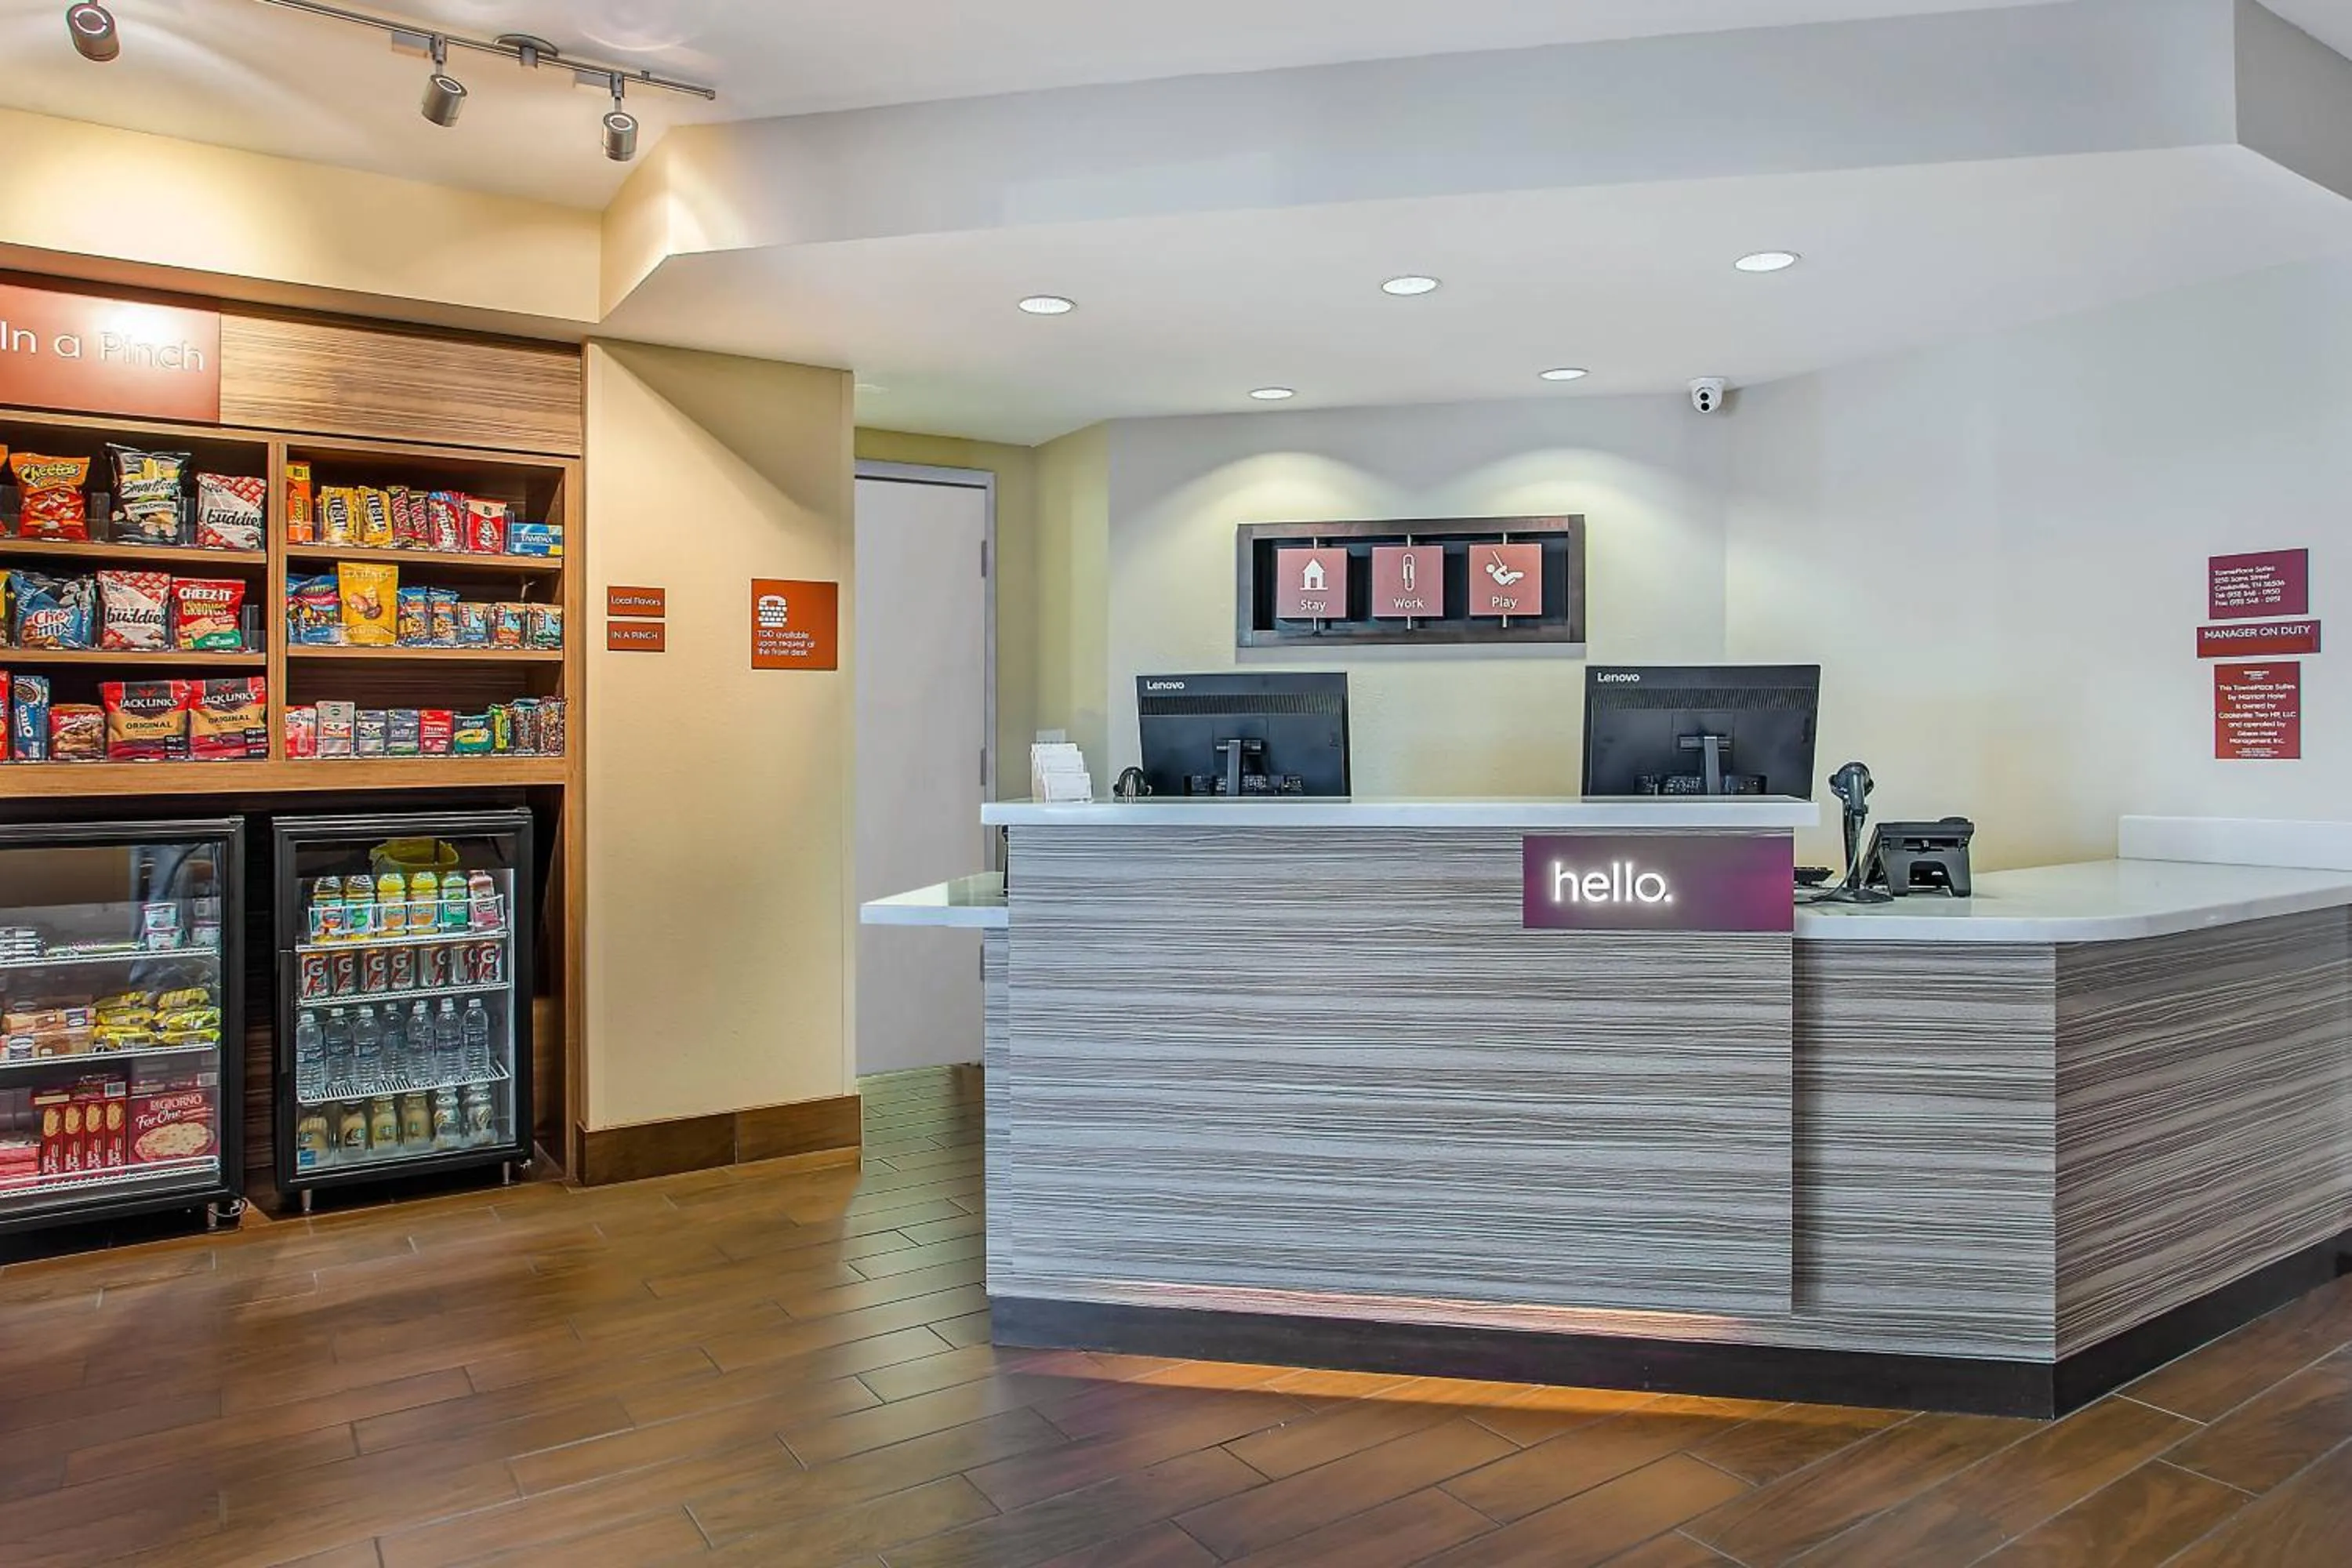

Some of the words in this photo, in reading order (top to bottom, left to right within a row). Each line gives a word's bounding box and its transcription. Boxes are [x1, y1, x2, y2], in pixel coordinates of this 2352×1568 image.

[0, 320, 38, 353] In
[53, 333, 82, 358] a
[100, 331, 204, 372] Pinch
[612, 595, 633, 605] Local
[633, 597, 661, 606] Flavors
[1300, 599, 1327, 612] Stay
[1393, 597, 1424, 609] Work
[1492, 596, 1518, 610] Play
[623, 630, 630, 639] A
[631, 631, 659, 640] PINCH
[2205, 628, 2257, 639] MANAGER
[2259, 626, 2278, 637] ON
[2281, 625, 2311, 635] DUTY
[1597, 672, 1640, 683] Lenovo
[1146, 680, 1185, 691] Lenovo
[125, 720, 172, 730] ORIGINAL
[1553, 861, 1674, 903] hello.
